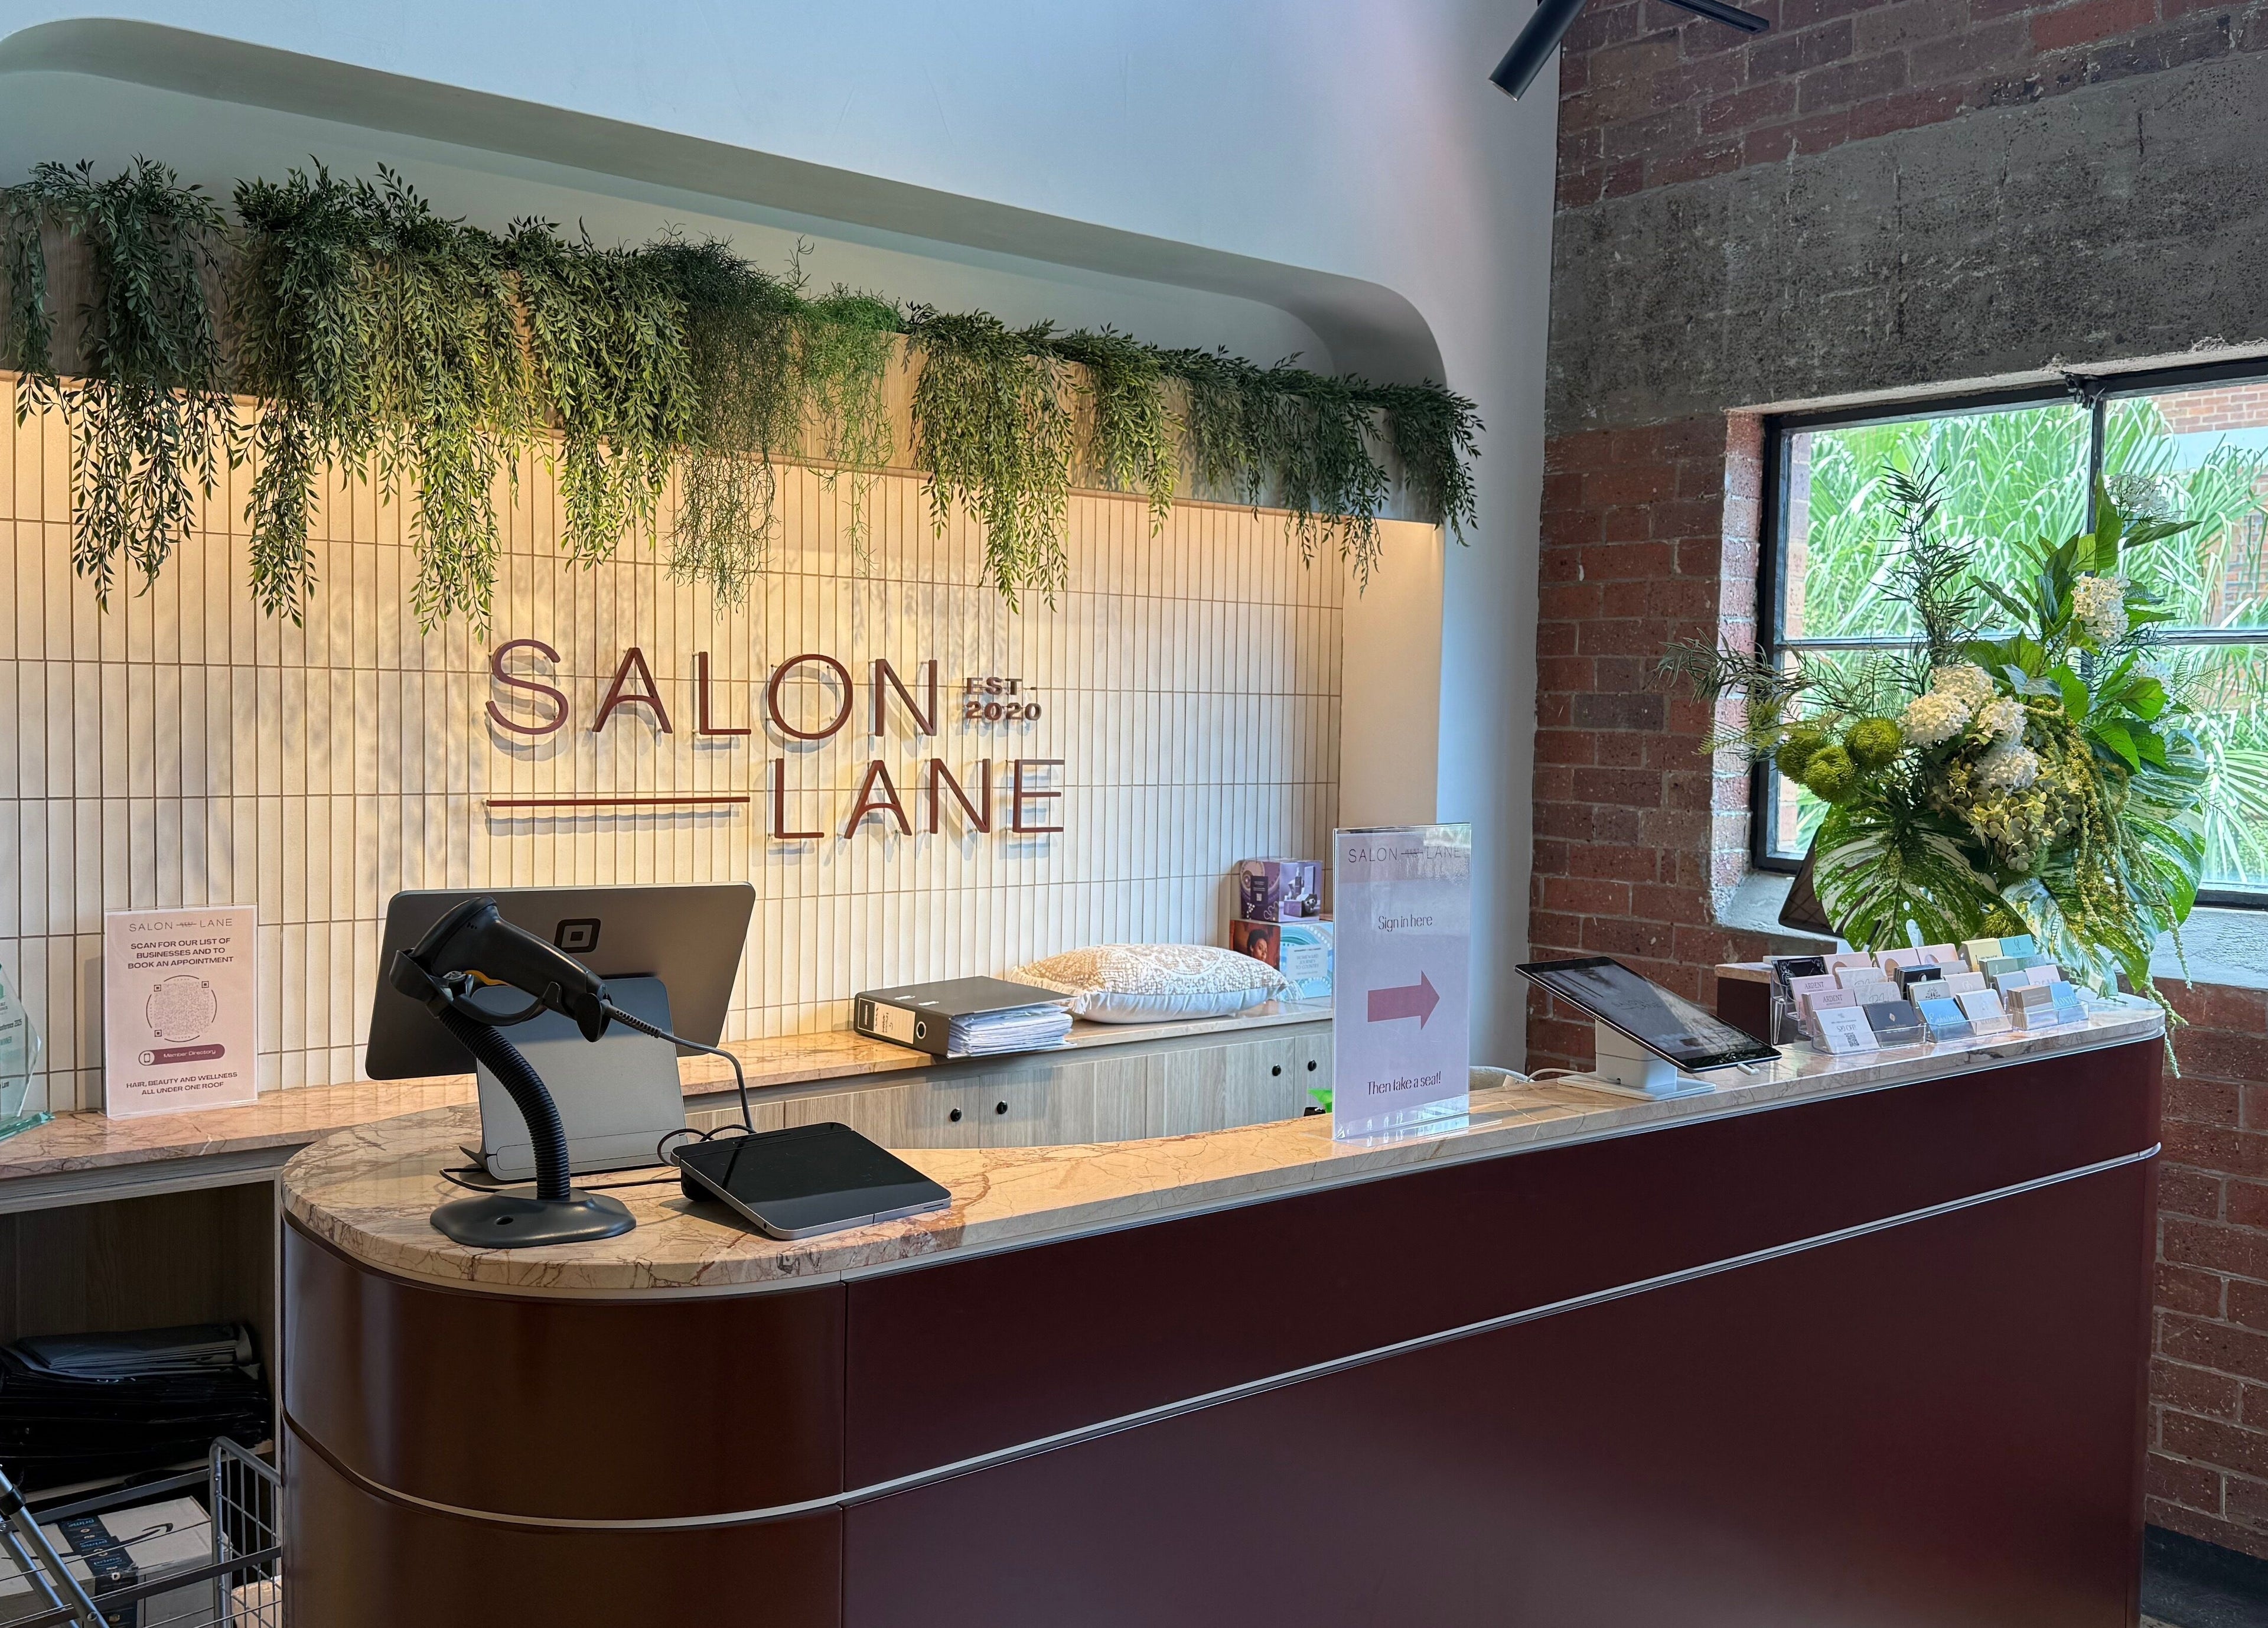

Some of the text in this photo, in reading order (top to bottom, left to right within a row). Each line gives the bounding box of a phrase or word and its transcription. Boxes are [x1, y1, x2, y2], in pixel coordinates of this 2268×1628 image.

[485, 638, 938, 740] SALON
[966, 701, 1042, 720] 2020
[774, 758, 1064, 839] LANE
[1348, 846, 1461, 863] SALON LANE
[129, 922, 173, 932] SALON
[200, 919, 233, 928] LANE
[1378, 914, 1433, 932] Sign in here
[136, 949, 191, 959] BUSINESSES
[128, 961, 154, 969] BOOK
[171, 956, 234, 966] APPOINTMENT
[1804, 981, 1824, 989] ARDENT
[1823, 994, 1843, 1002] ARDENT
[148, 1078, 178, 1086] BEAUTY
[198, 1072, 237, 1081] WELLNESS
[1367, 1070, 1441, 1095] Then take a seat!
[157, 1085, 183, 1093] UNDER
